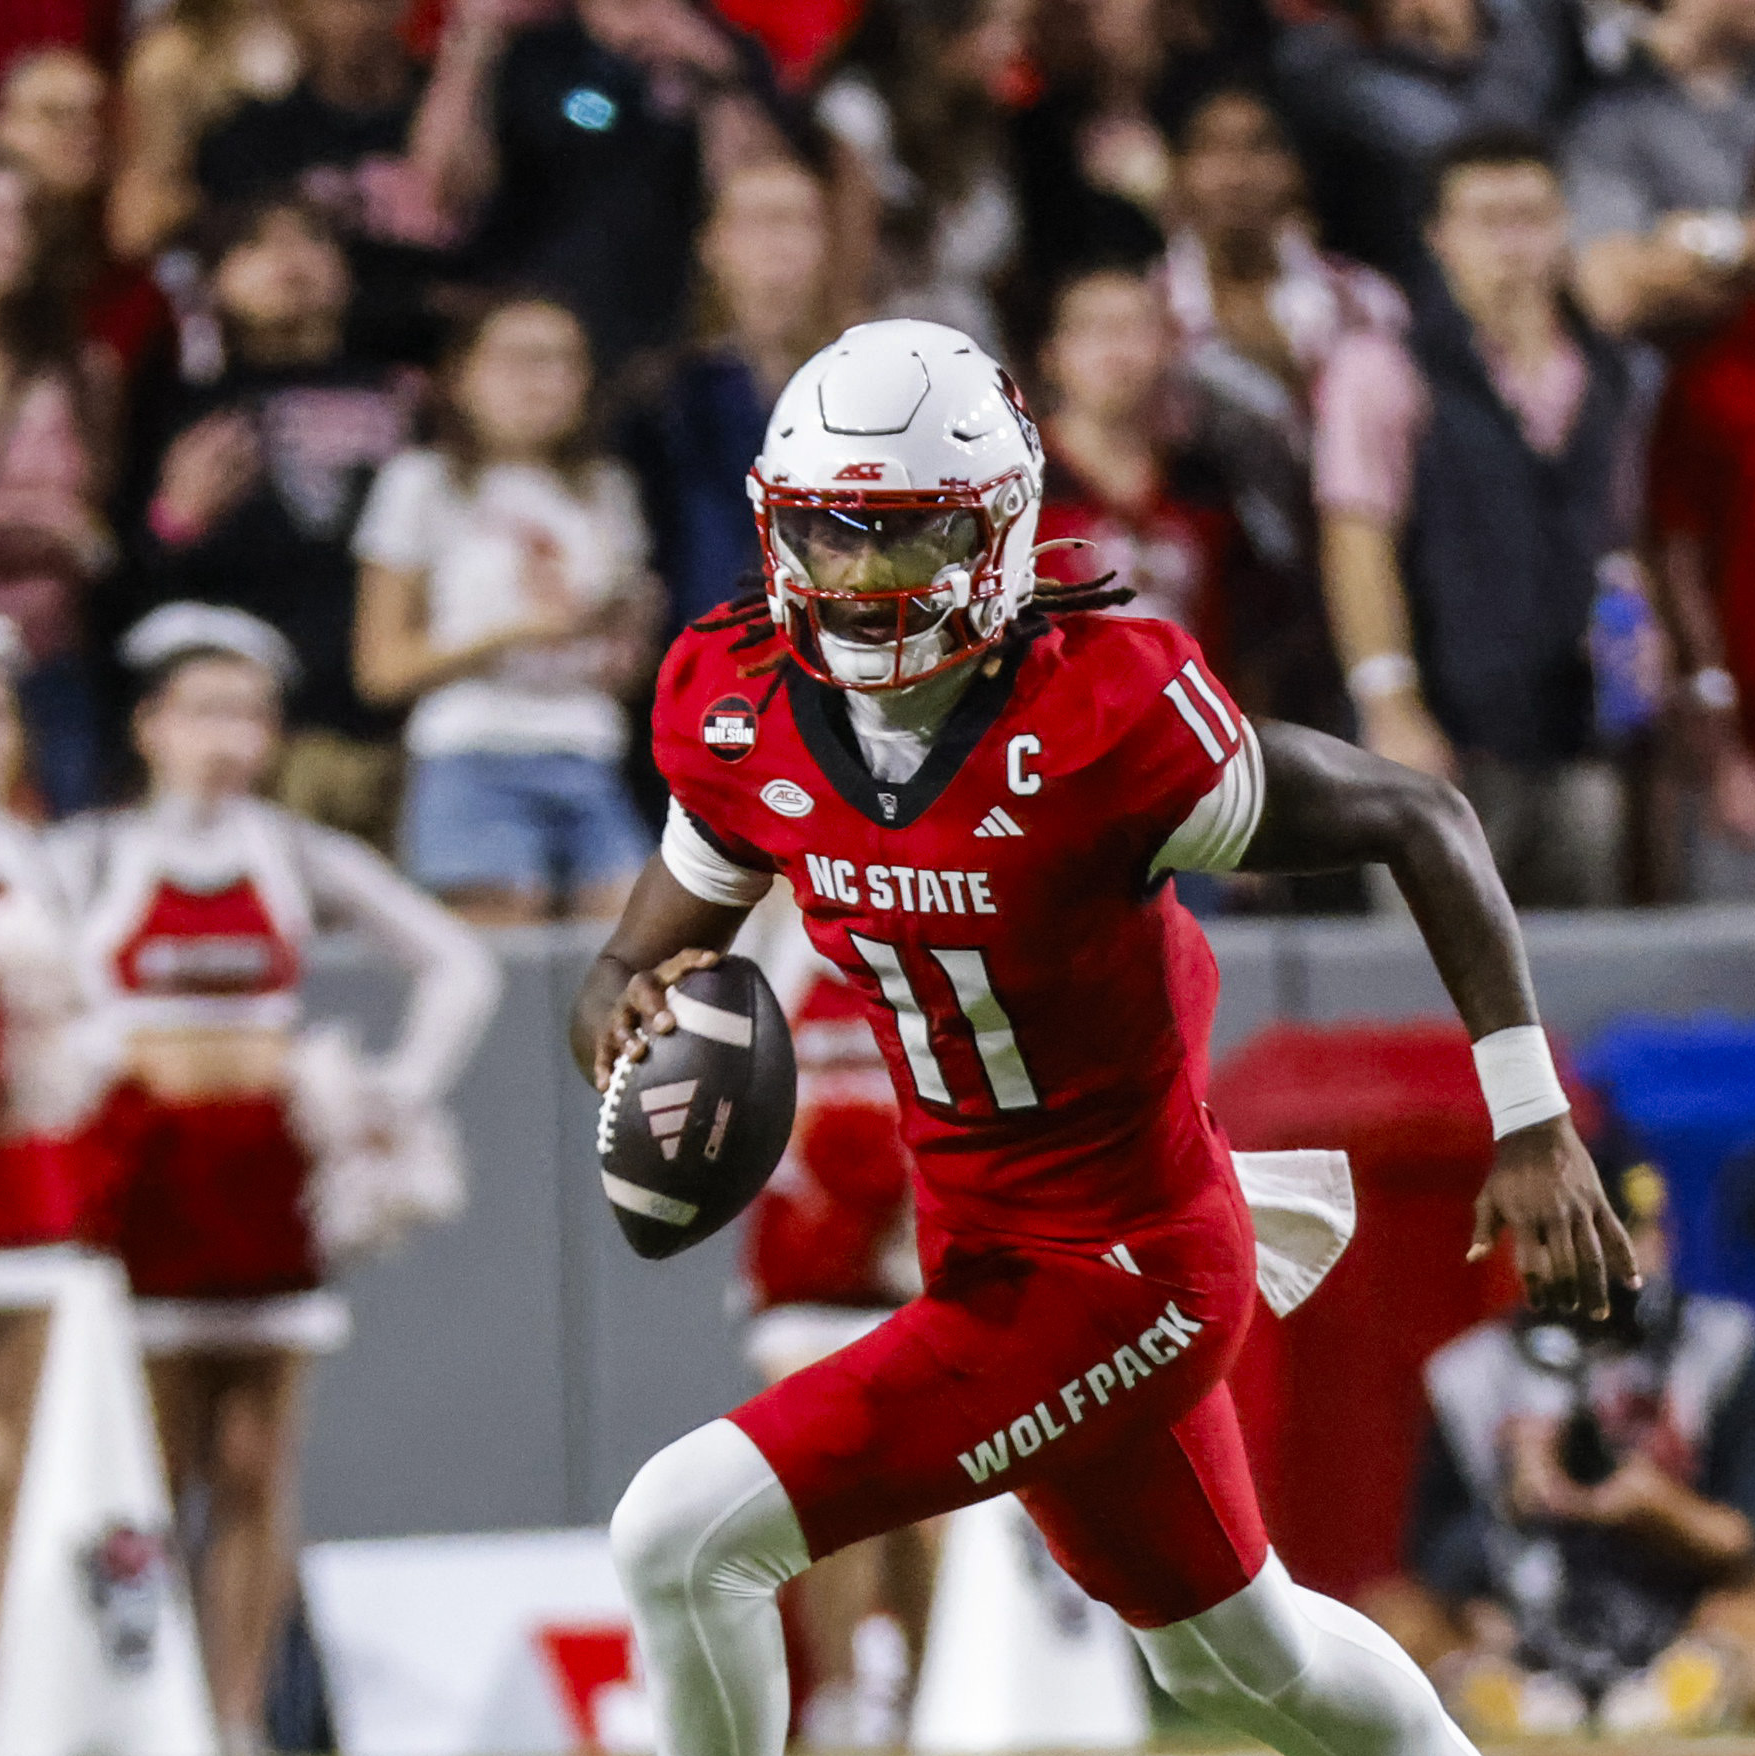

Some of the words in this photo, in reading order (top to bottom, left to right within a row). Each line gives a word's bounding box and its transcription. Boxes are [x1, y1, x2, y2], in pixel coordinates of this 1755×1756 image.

[832, 462, 886, 481] ACC
[704, 727, 754, 745] WILSON
[1162, 658, 1239, 764] 11
[1007, 733, 1042, 796] C
[772, 789, 804, 803] ACC
[804, 852, 860, 905] NC
[864, 864, 997, 914] STATE
[847, 930, 1040, 1111] 11
[956, 1299, 1204, 1485] WOLFPACK
